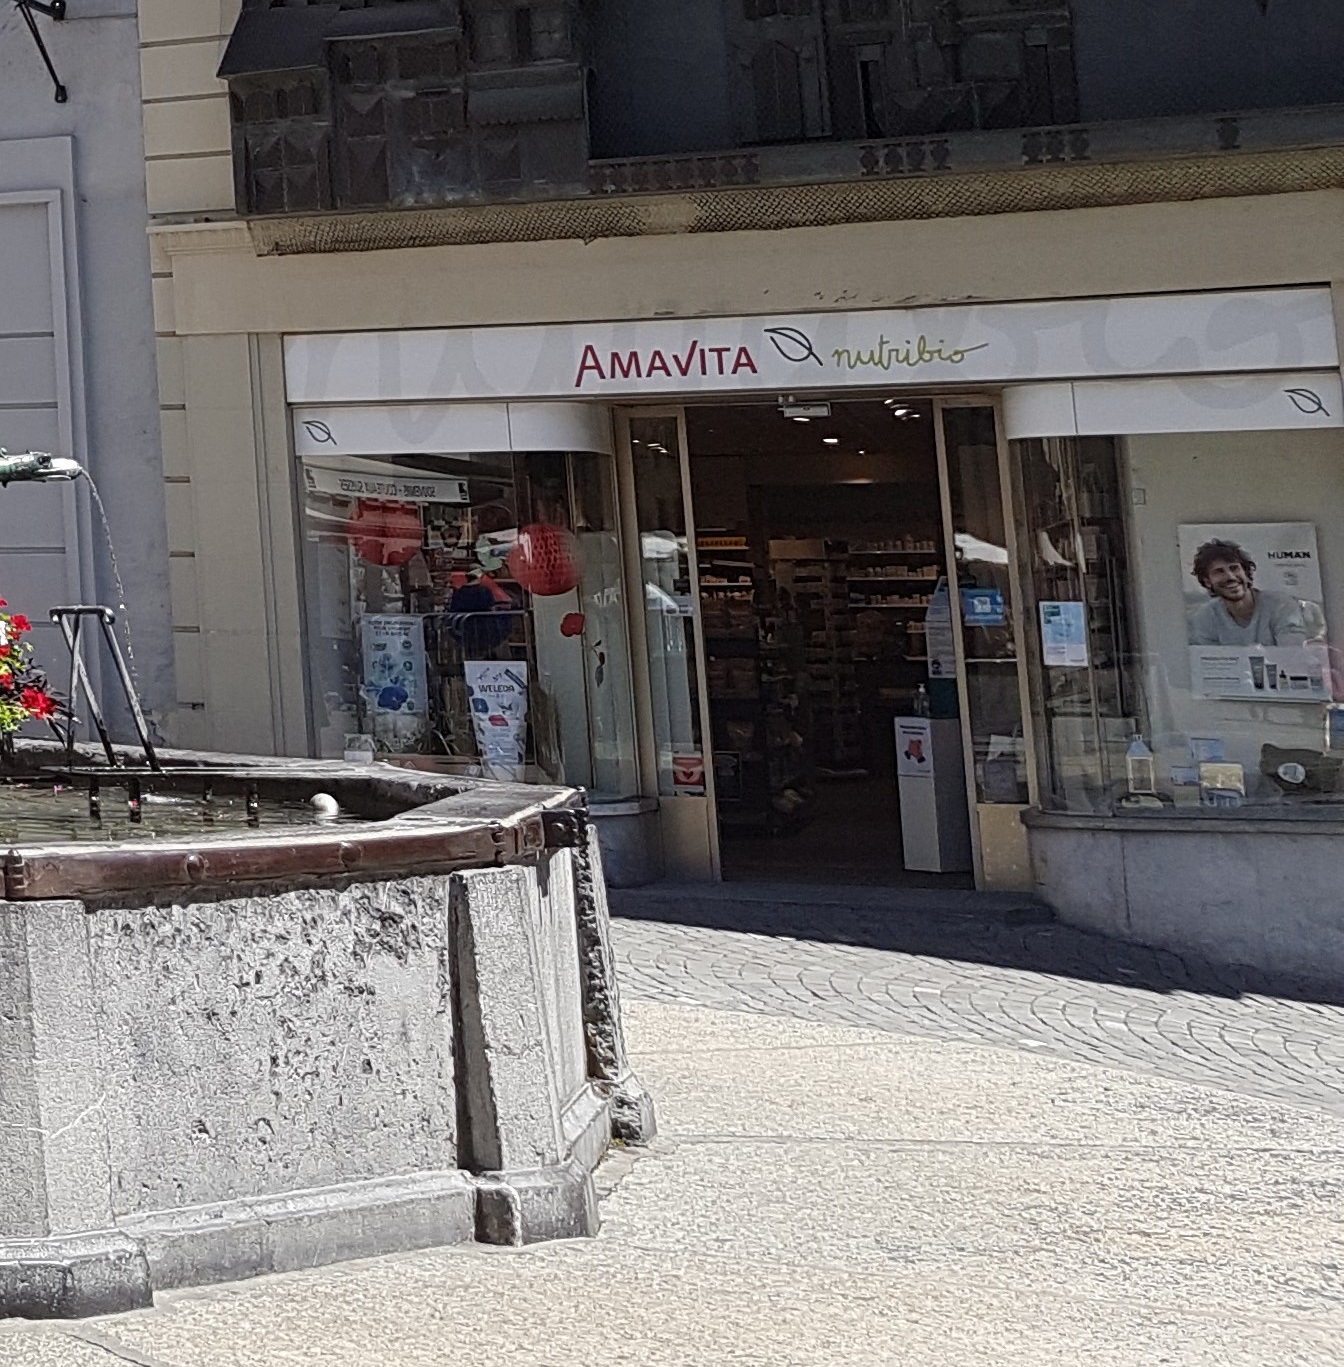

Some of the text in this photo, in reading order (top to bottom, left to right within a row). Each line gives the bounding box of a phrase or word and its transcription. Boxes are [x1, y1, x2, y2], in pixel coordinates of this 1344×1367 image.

[574, 333, 989, 388] AMAVITA nutribio
[478, 685, 515, 693] WELEDA
